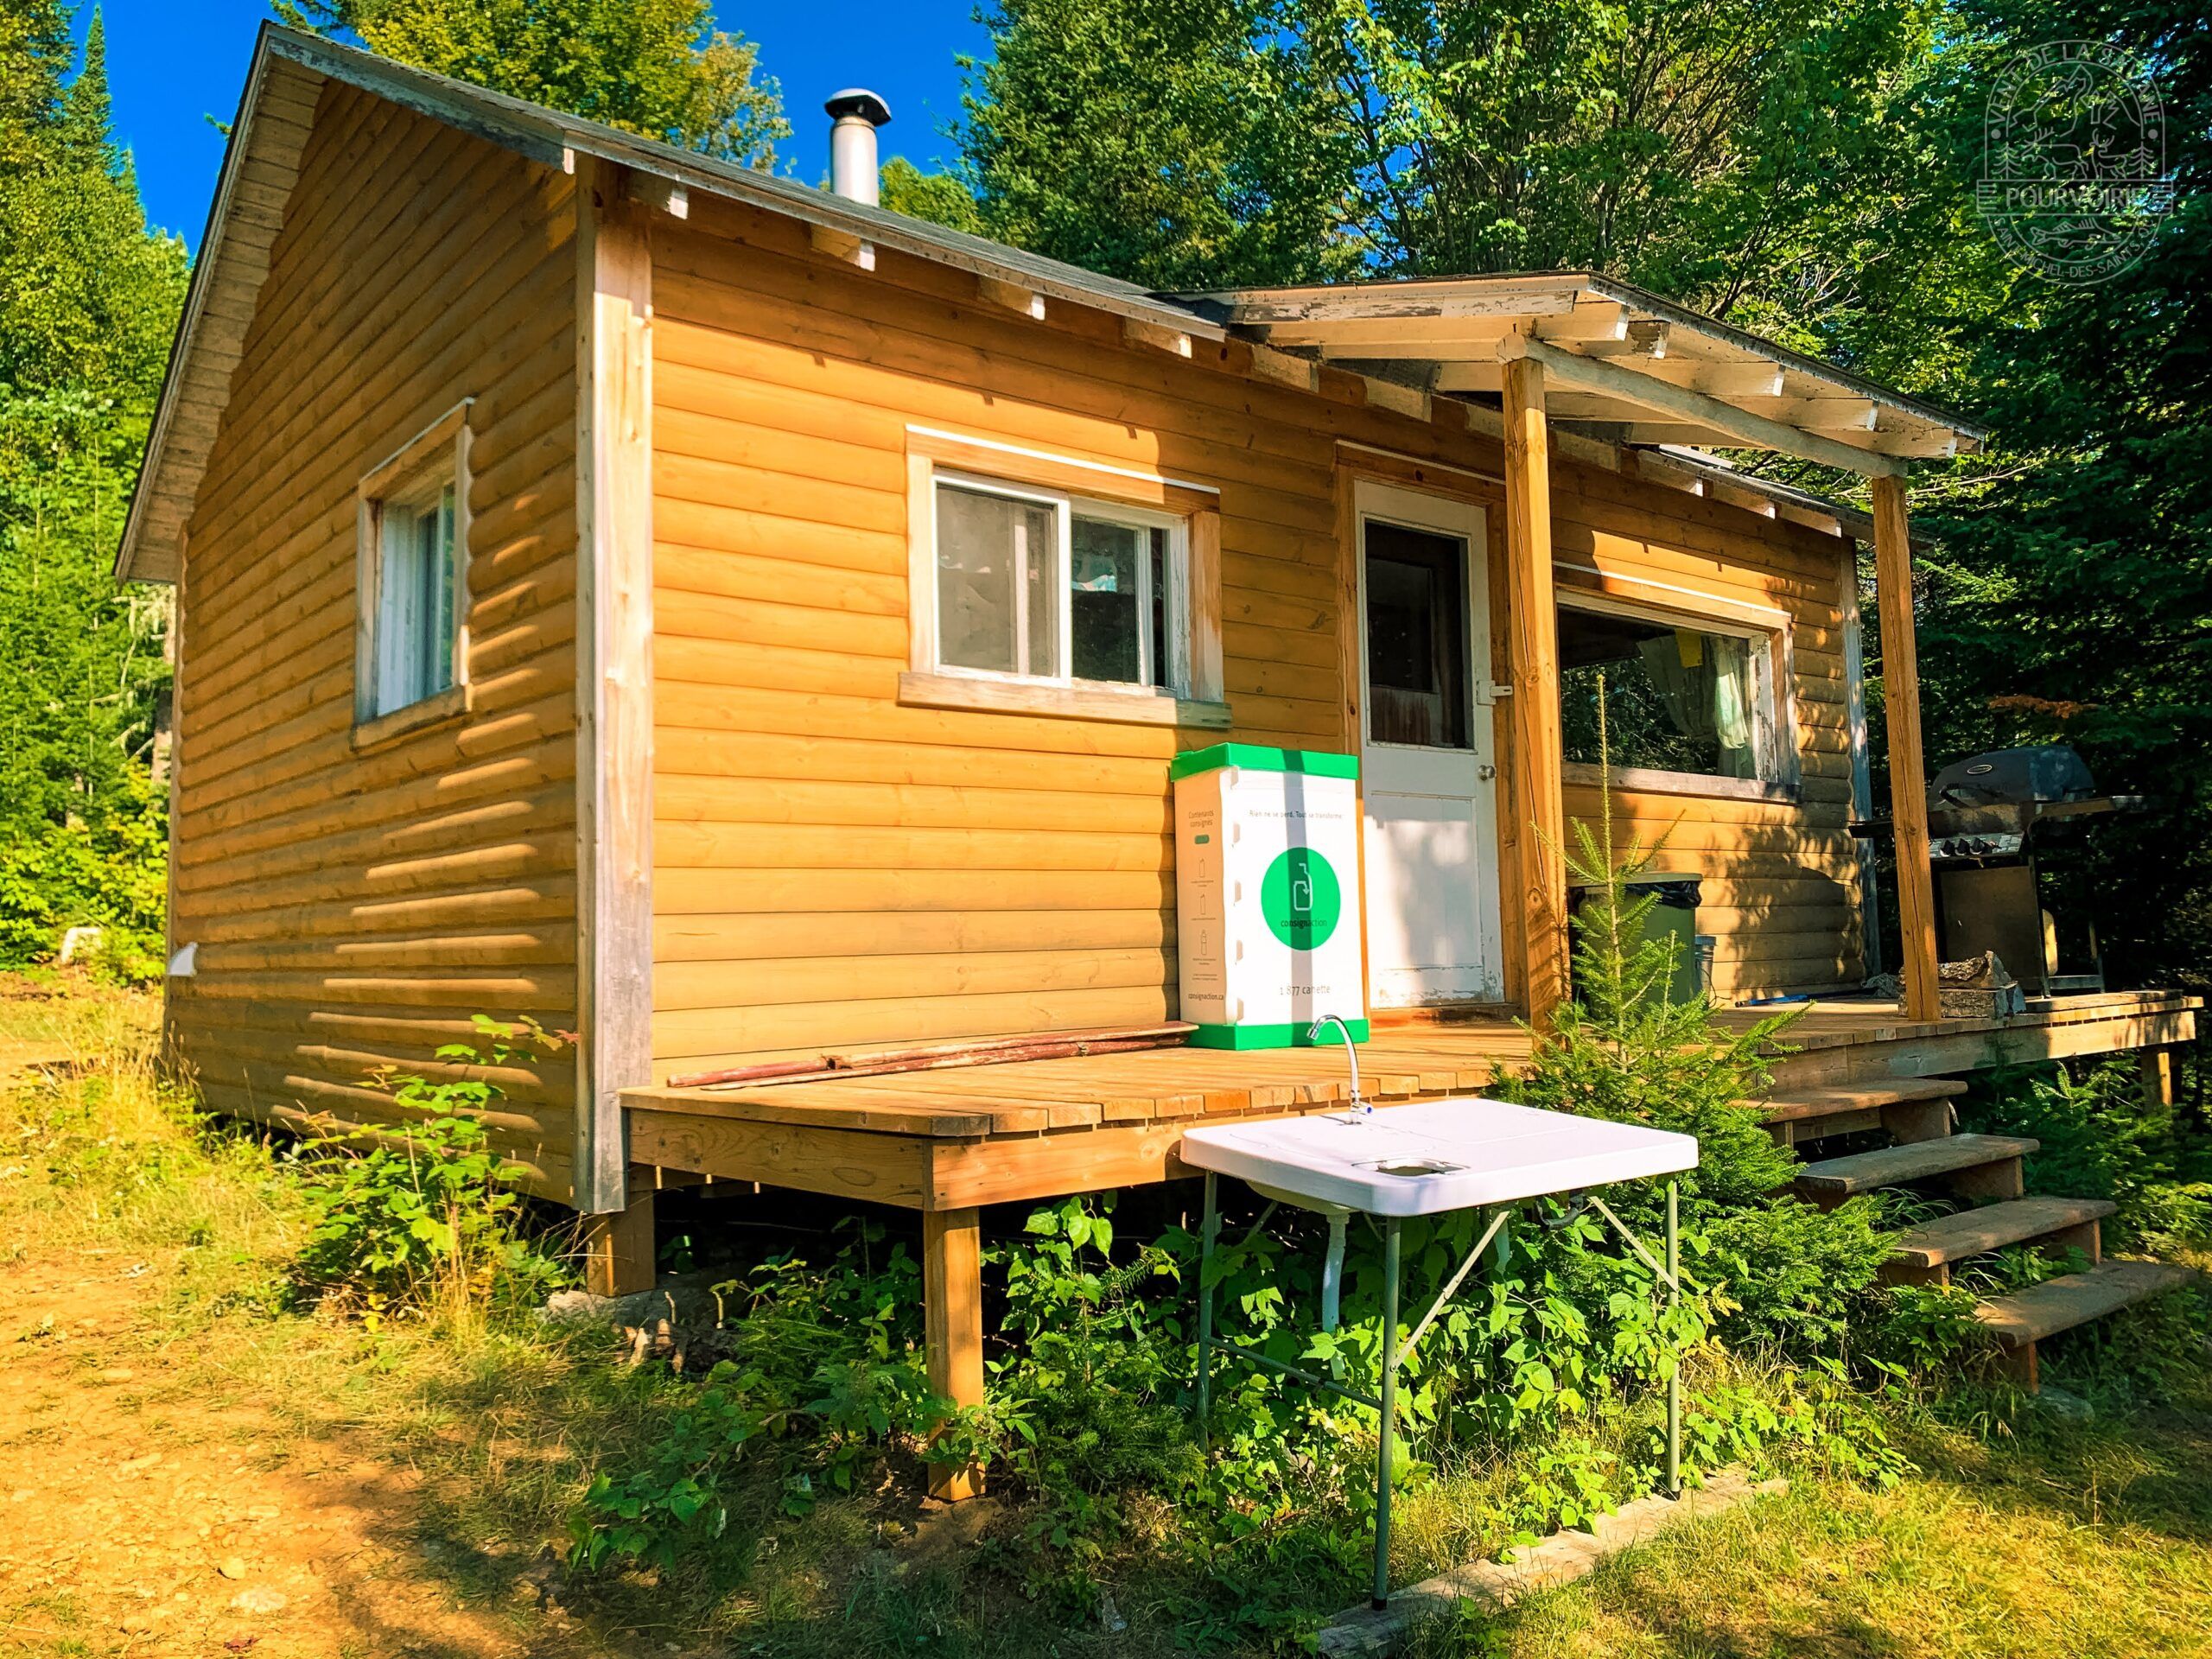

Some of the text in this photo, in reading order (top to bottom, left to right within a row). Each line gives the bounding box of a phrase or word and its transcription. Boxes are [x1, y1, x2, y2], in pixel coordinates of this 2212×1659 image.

[1281, 918, 1327, 930] consignaction
[1286, 986, 1300, 996] 877
[1302, 985, 1331, 995] canette
[1188, 993, 1224, 1001] consignaction.ca
